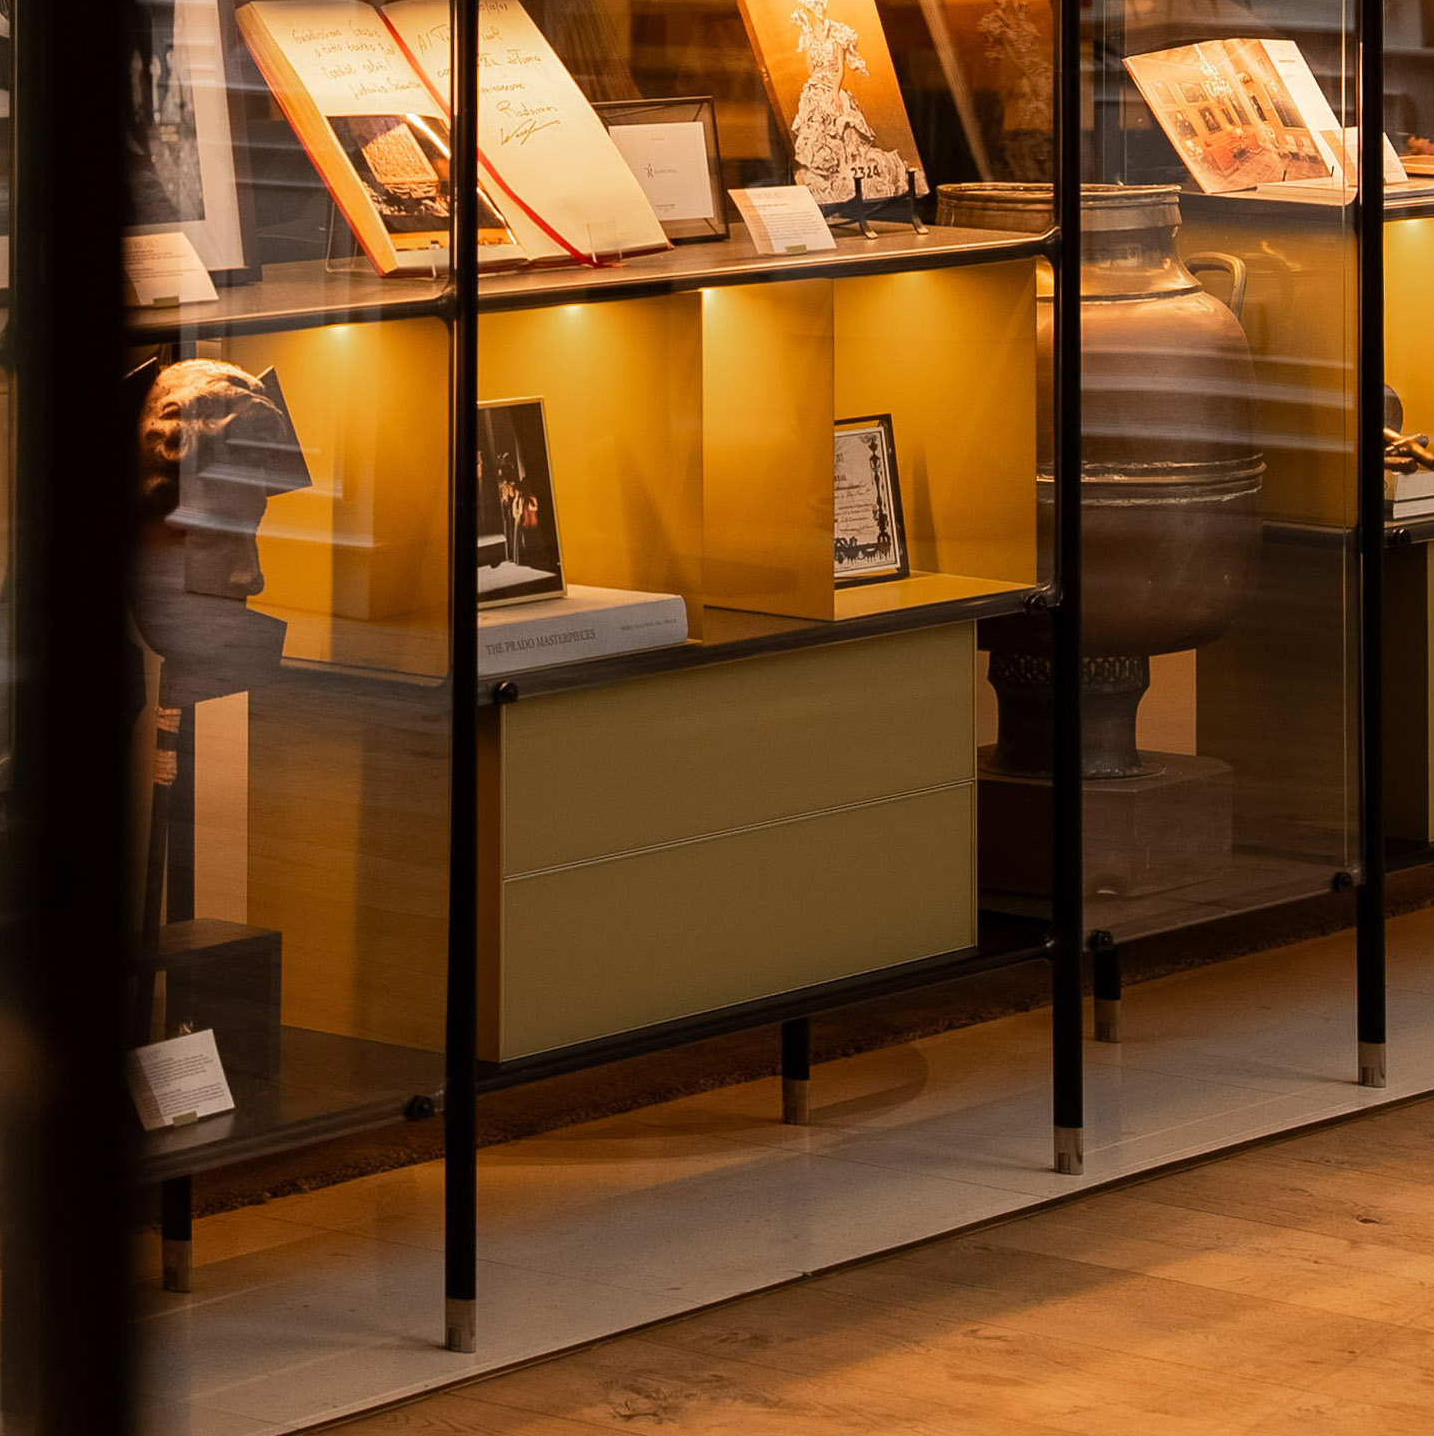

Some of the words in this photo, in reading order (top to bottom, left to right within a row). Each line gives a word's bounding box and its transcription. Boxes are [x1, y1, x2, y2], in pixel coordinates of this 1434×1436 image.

[485, 641, 504, 656] THE
[505, 637, 535, 653] PRADO
[536, 628, 596, 648] MASTERPIECES
